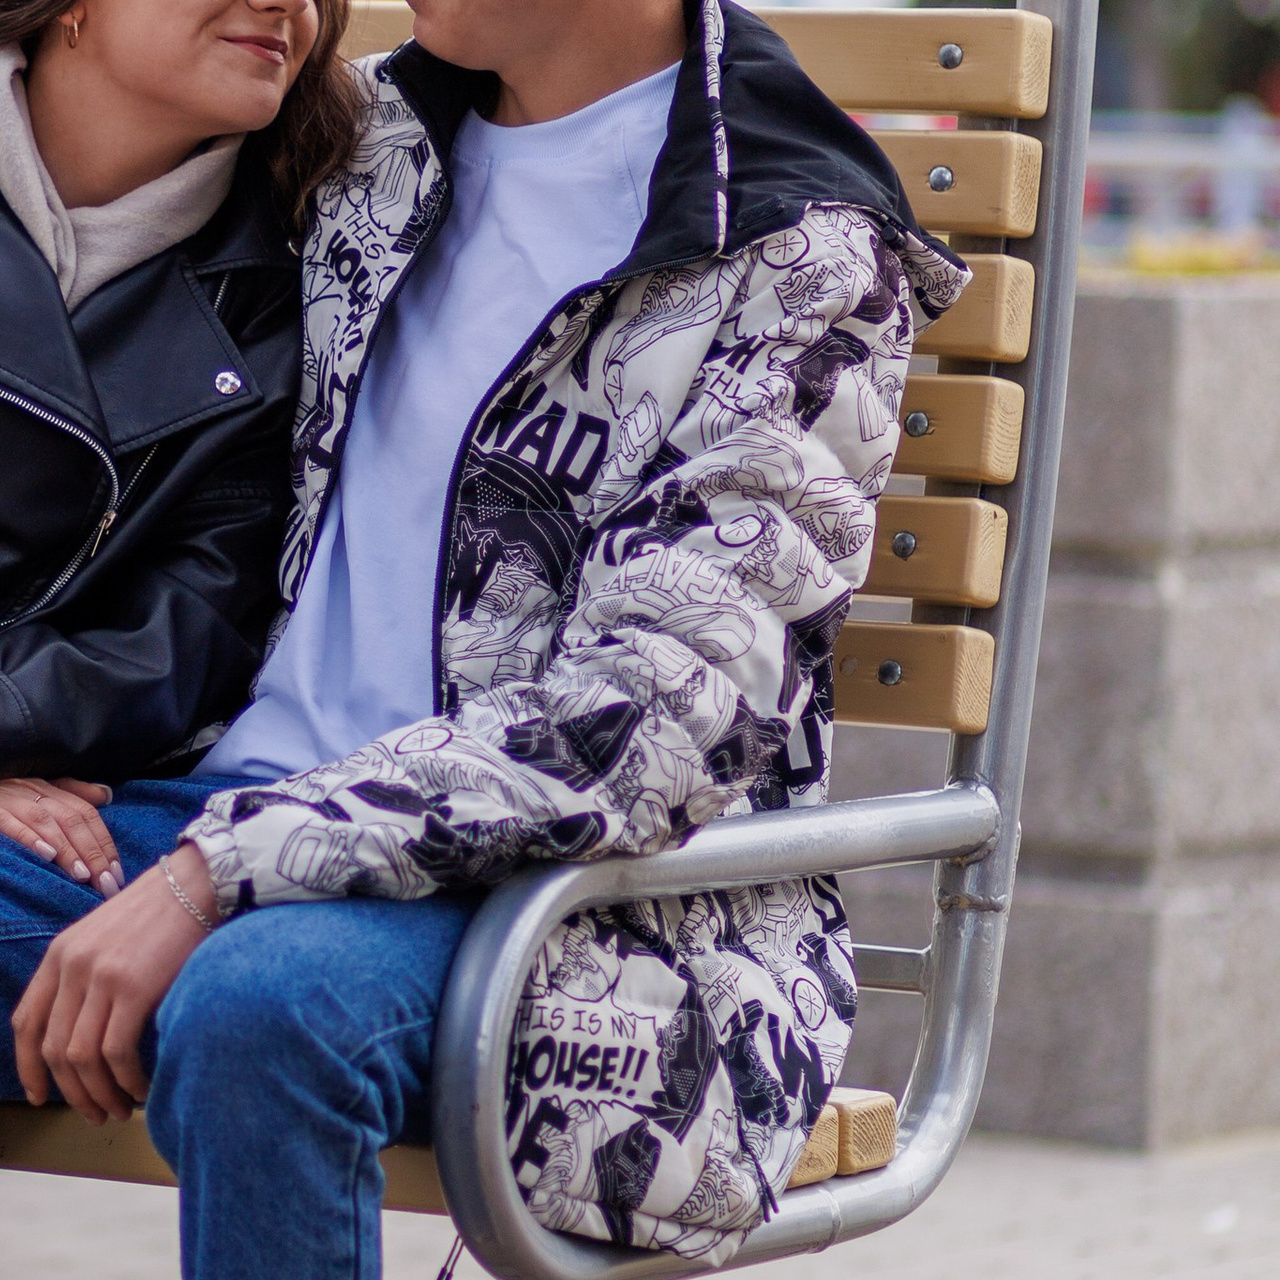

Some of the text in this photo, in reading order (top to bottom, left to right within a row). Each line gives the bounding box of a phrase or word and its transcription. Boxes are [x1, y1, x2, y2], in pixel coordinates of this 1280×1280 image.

[344, 207, 387, 260] THIS
[517, 1002, 636, 1039] HIS IS MY
